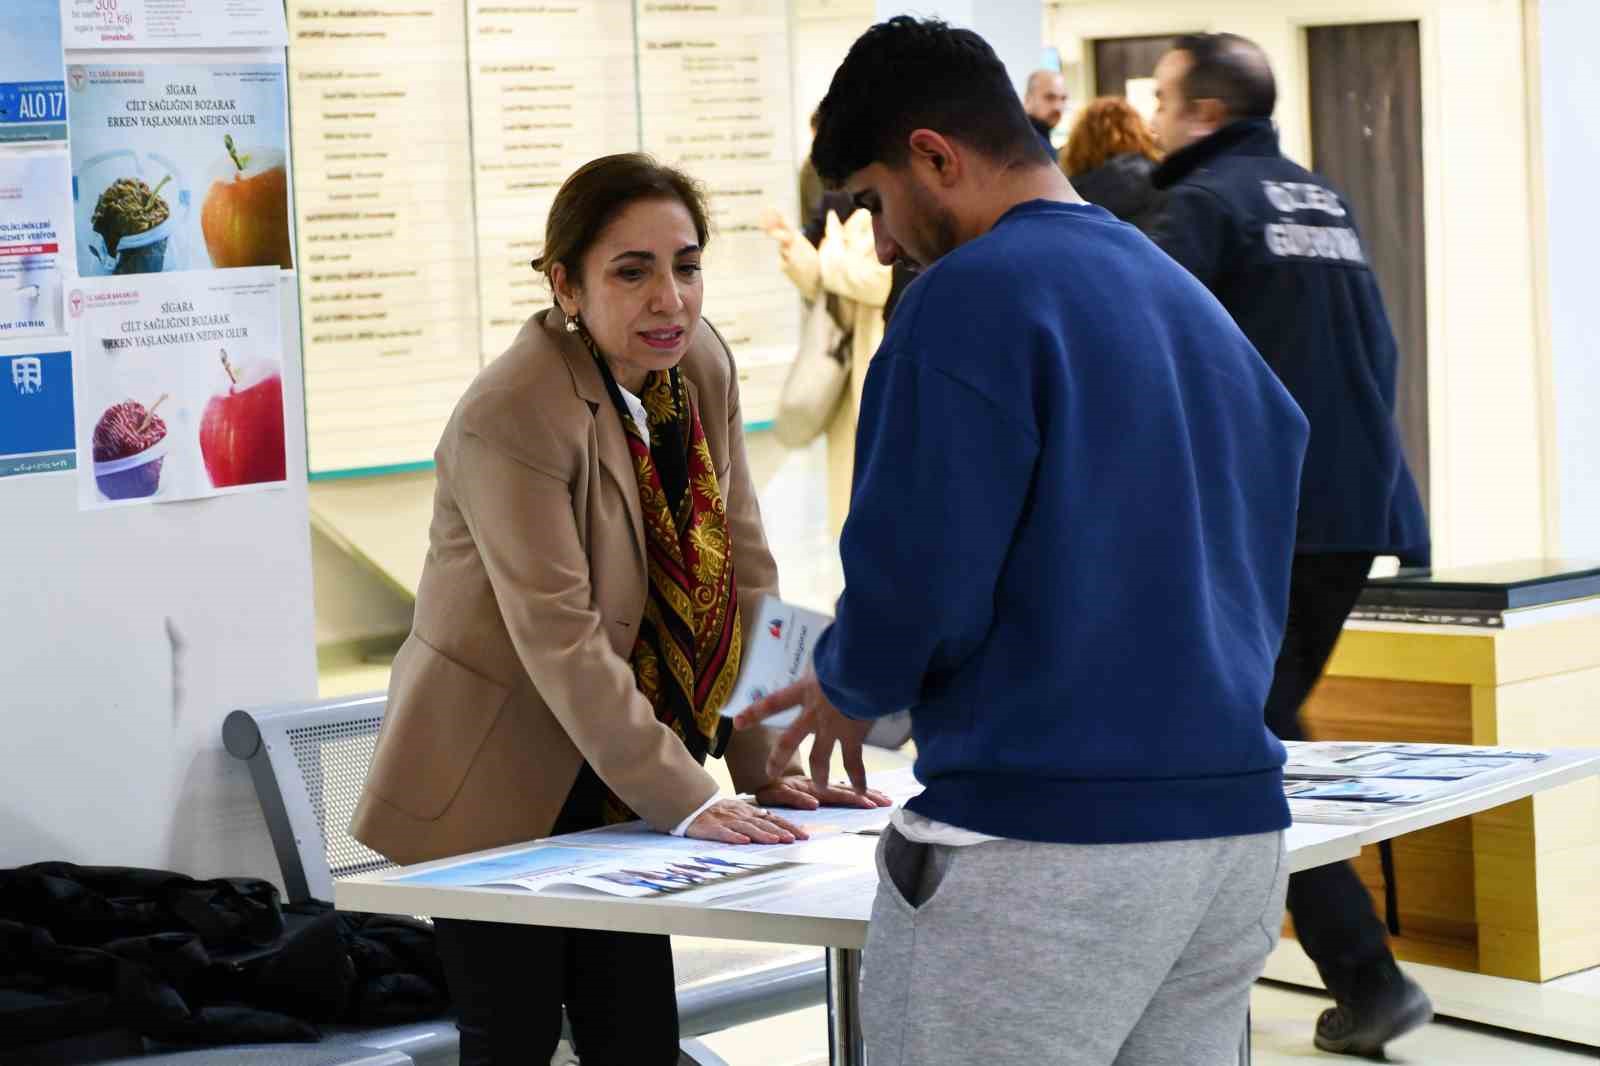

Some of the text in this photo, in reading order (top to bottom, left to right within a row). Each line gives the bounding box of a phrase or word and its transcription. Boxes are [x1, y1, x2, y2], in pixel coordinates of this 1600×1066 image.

[166, 83, 198, 96] SİGARA
[20, 93, 46, 118] ALO
[126, 98, 236, 112] CİLT SAĞLIĞINI BOZARAK
[107, 114, 256, 128] ERKEN YAŞLANMAYA NEDEN OLUR
[161, 301, 194, 313] SİGARA
[121, 314, 231, 332] CİLT SAĞLIĞINI BOZARAK
[135, 332, 196, 348] YAŞLANMAYA
[197, 330, 224, 341] NEDEN
[226, 327, 249, 338] OLUR
